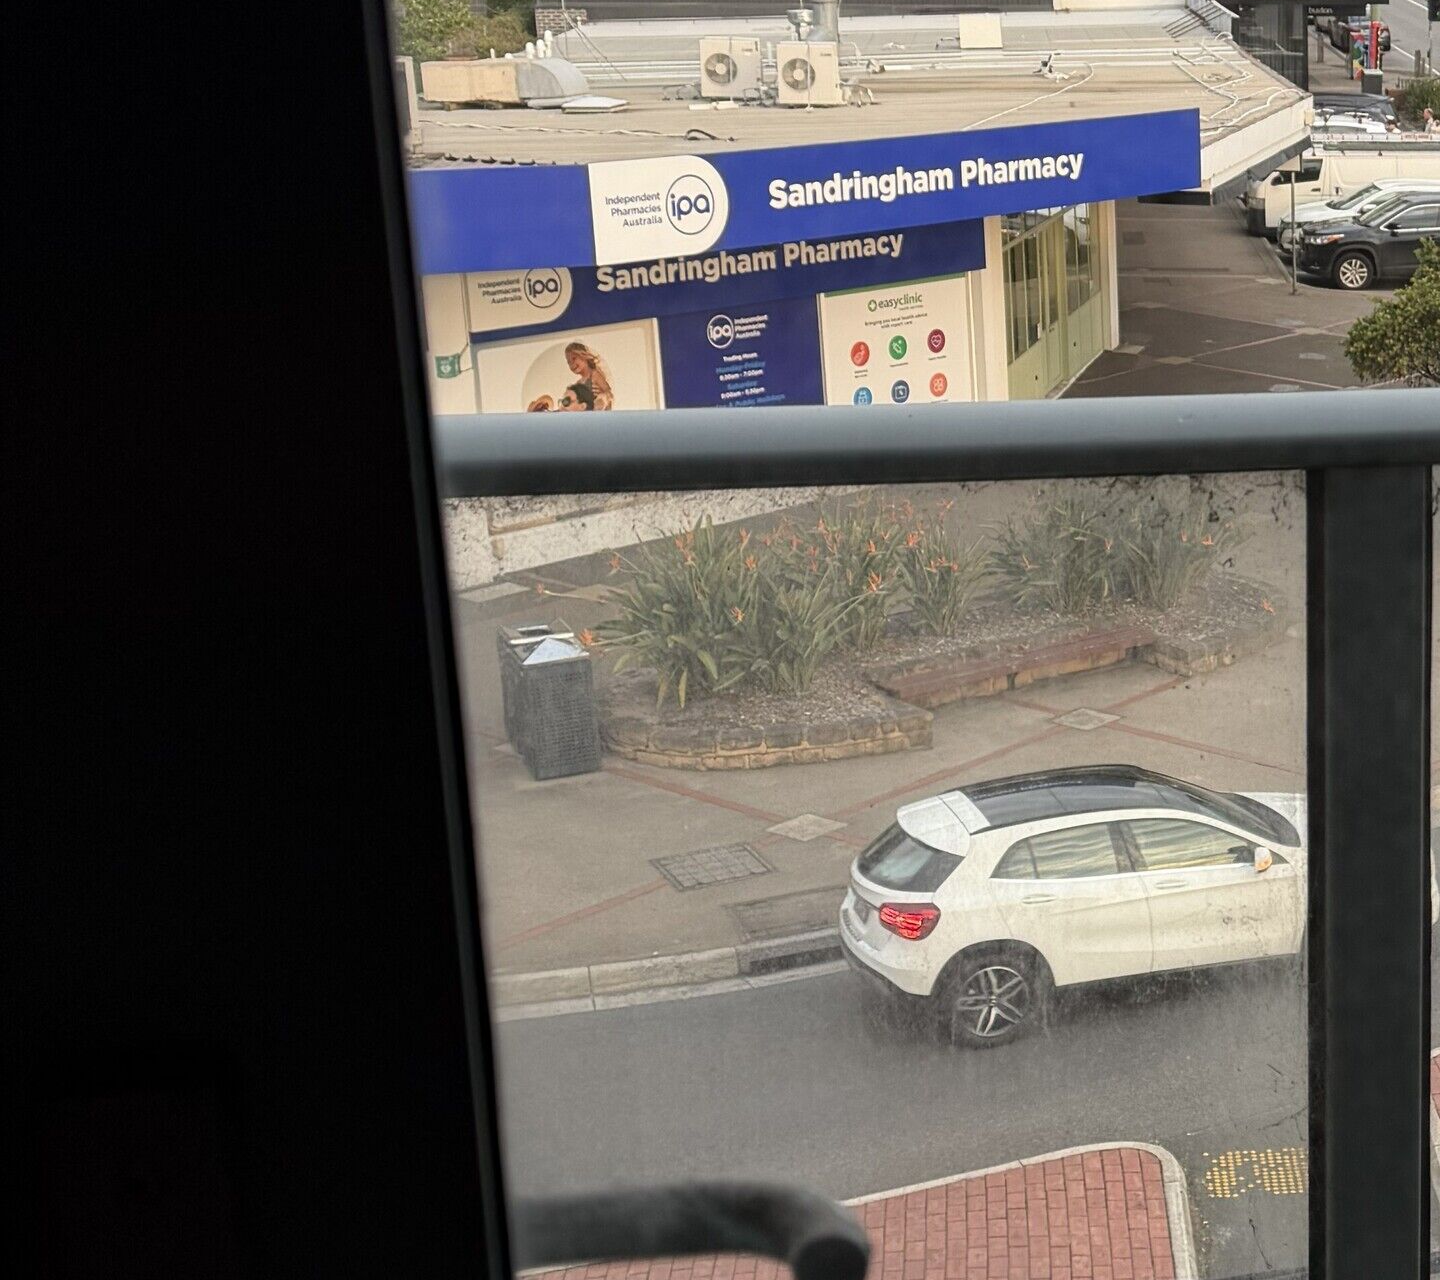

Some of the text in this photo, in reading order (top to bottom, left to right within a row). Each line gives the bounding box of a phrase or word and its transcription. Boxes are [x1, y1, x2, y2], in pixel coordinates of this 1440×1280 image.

[768, 153, 1084, 210] Sandringham Pharmacy
[605, 192, 660, 205] Independent
[611, 204, 662, 217] Pharmacies
[670, 193, 710, 221] ipa
[623, 216, 663, 228] Australia
[596, 234, 904, 292] Sandringham Pharmacy
[478, 278, 520, 289] Independent
[528, 278, 559, 299] ipa
[482, 287, 521, 297] Pharmacies
[491, 295, 522, 305] Australia
[878, 292, 923, 309] easyclinic
[709, 323, 732, 341] ipa
